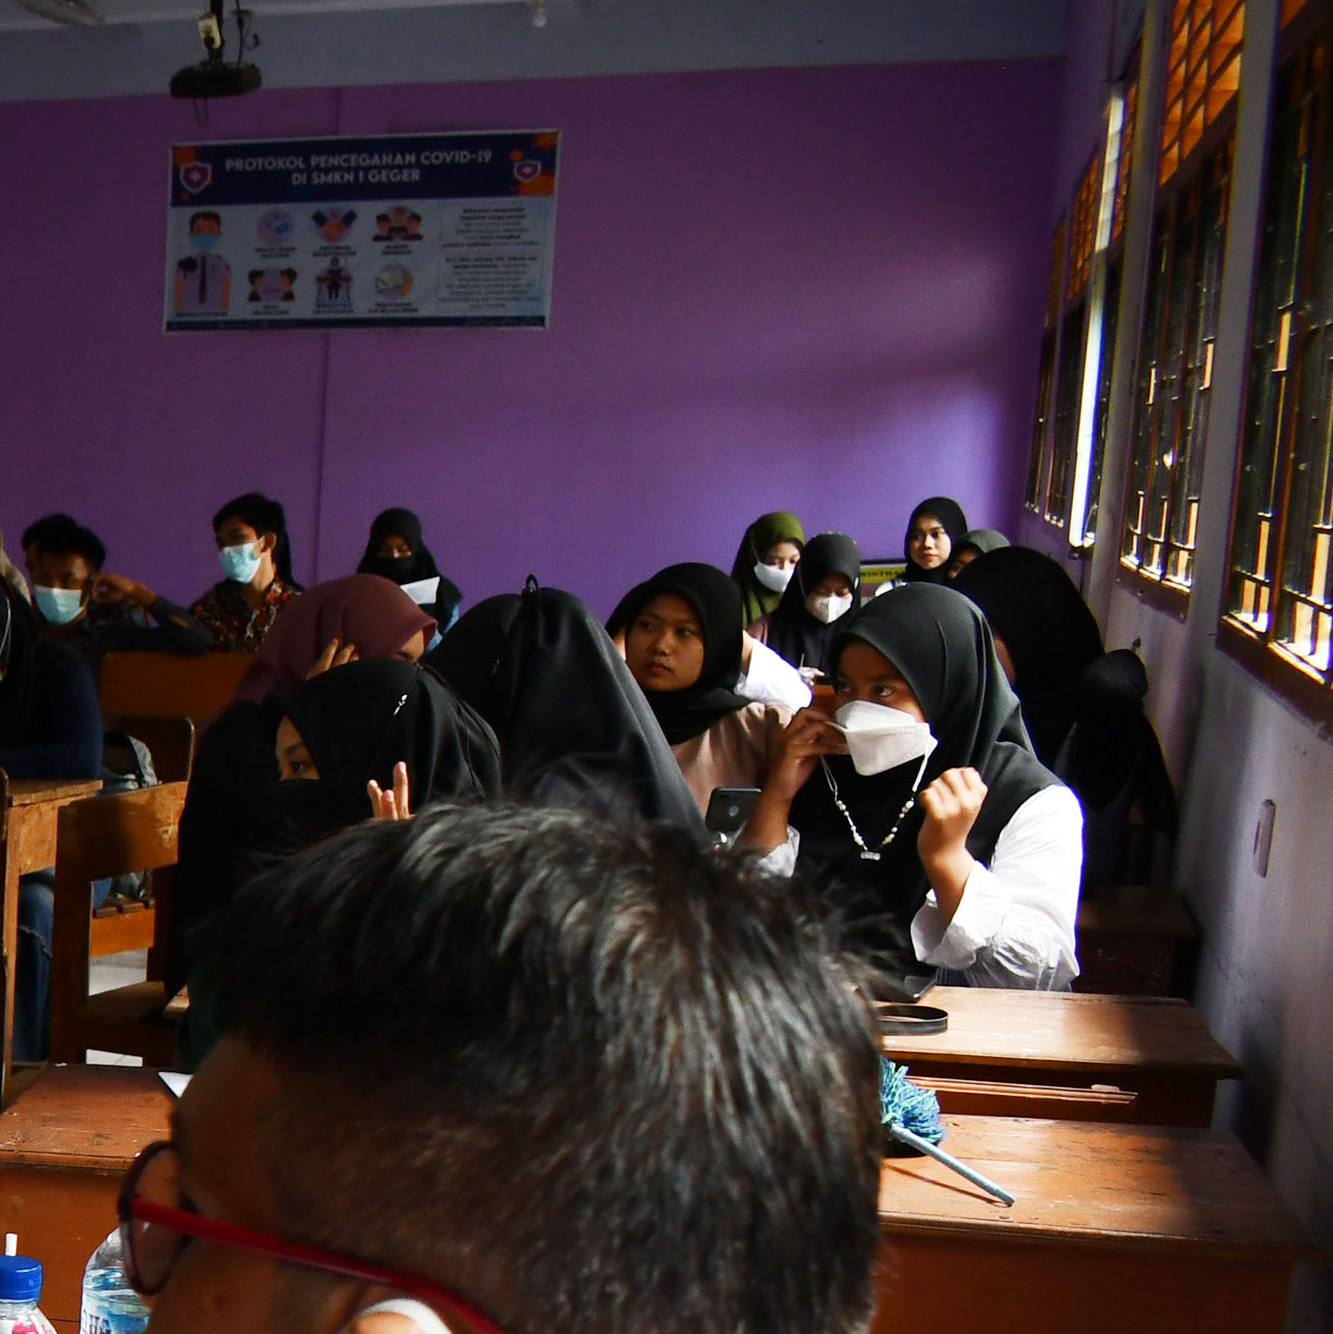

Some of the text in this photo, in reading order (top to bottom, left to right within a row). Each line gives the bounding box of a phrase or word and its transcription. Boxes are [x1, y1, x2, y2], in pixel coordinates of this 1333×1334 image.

[225, 149, 493, 172] PROTOKOL PENCEGAHAN COVID-19
[291, 172, 307, 186] DI
[311, 170, 355, 185] SMKN
[368, 168, 421, 183] GEGER
